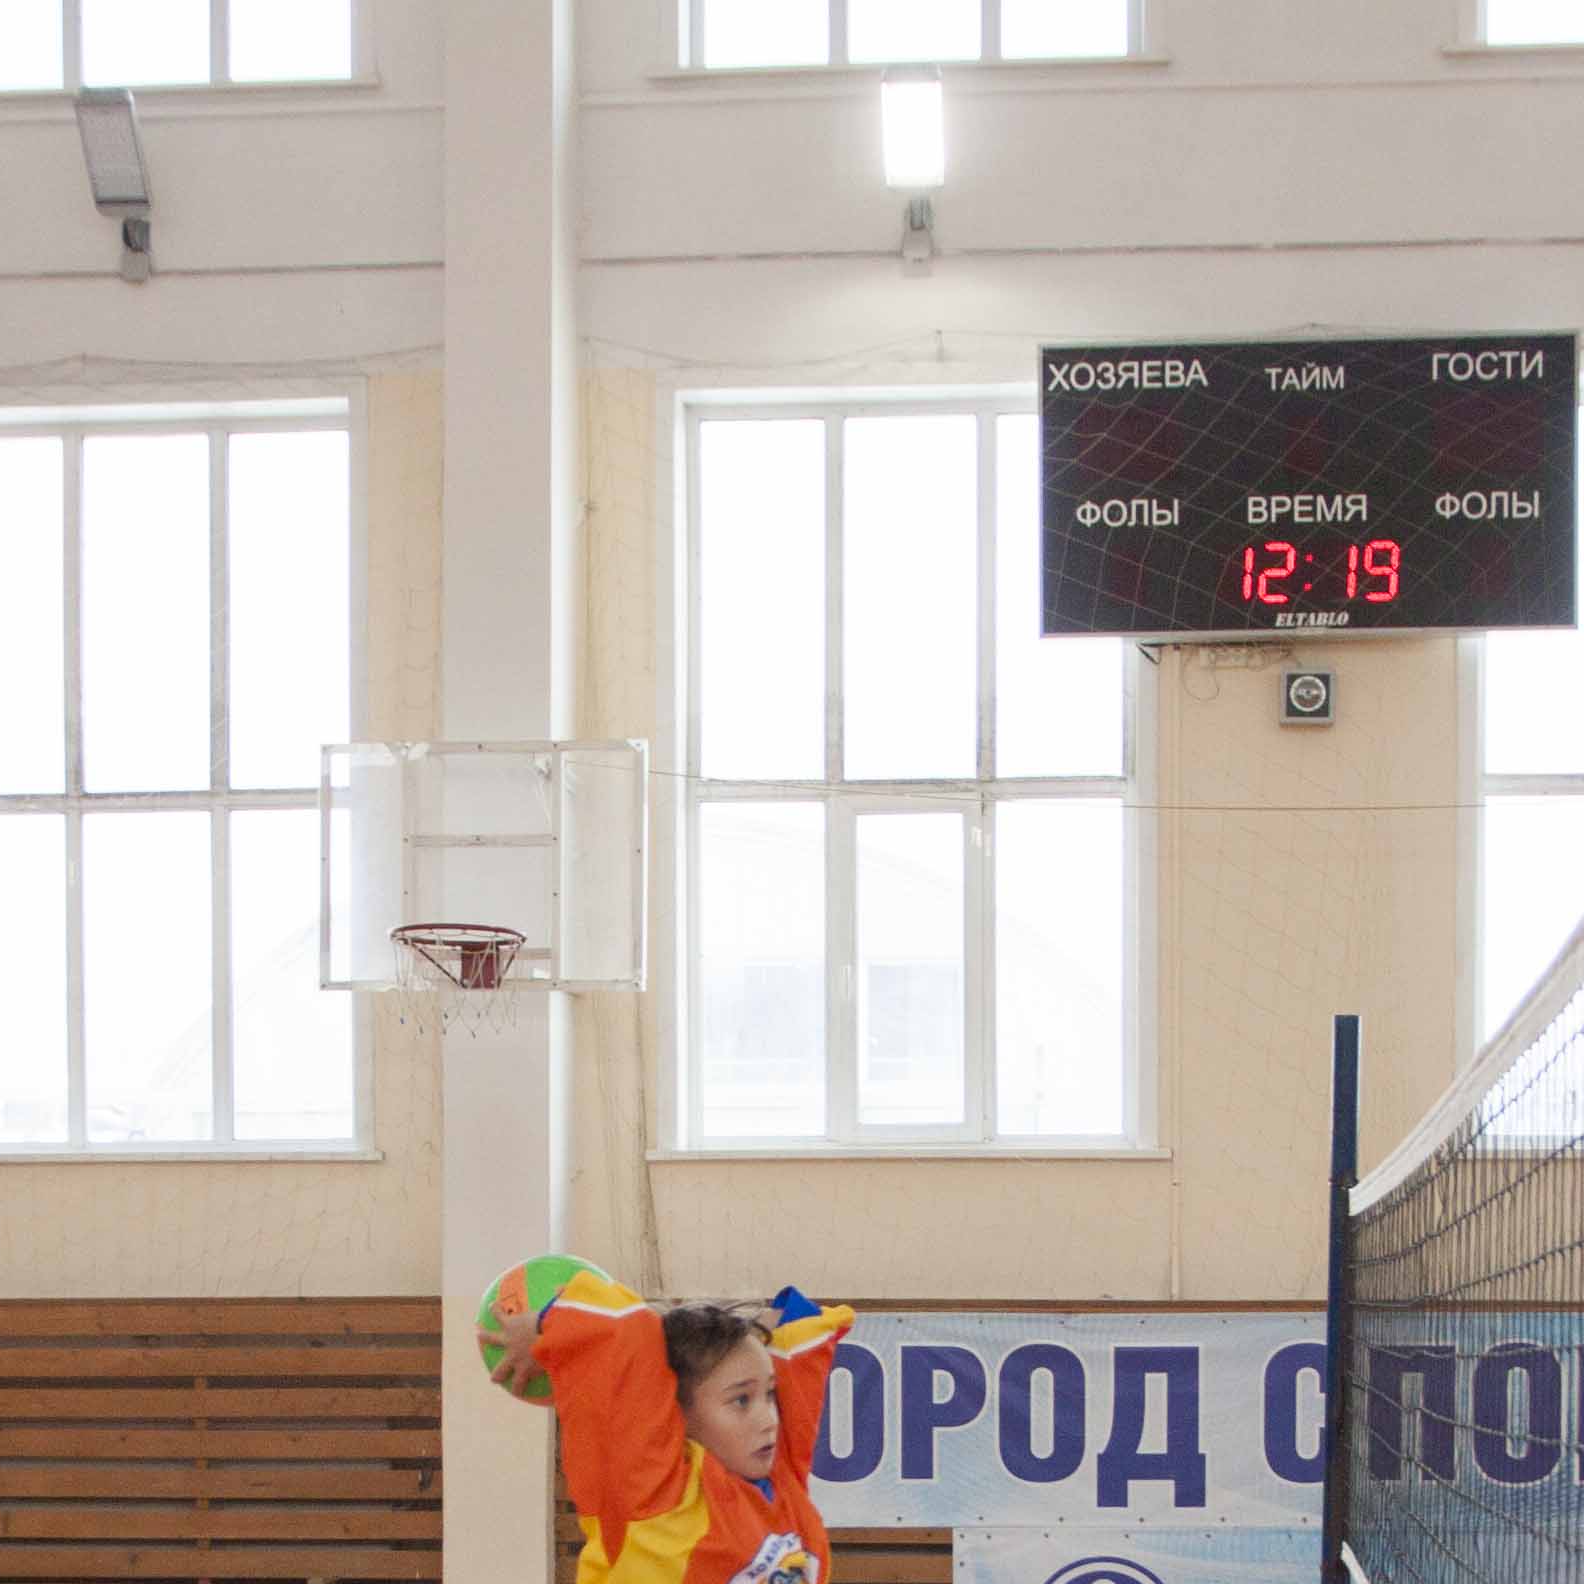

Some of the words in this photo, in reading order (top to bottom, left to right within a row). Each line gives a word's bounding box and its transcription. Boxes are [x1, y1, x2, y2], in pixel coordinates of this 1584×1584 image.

[1048, 359, 1209, 392] ХОЗЯЕВА
[1264, 364, 1345, 392] ТАЙМ
[1432, 351, 1544, 382] ГОСТИ
[1076, 499, 1179, 528] ФОЛЫ
[1247, 494, 1368, 525] ВРЕМЯ
[1435, 491, 1540, 521] ФОЛЫ
[1241, 540, 1401, 604] 12:19
[1275, 611, 1349, 628] ELTABLO
[810, 1342, 1207, 1508] ОРОД
